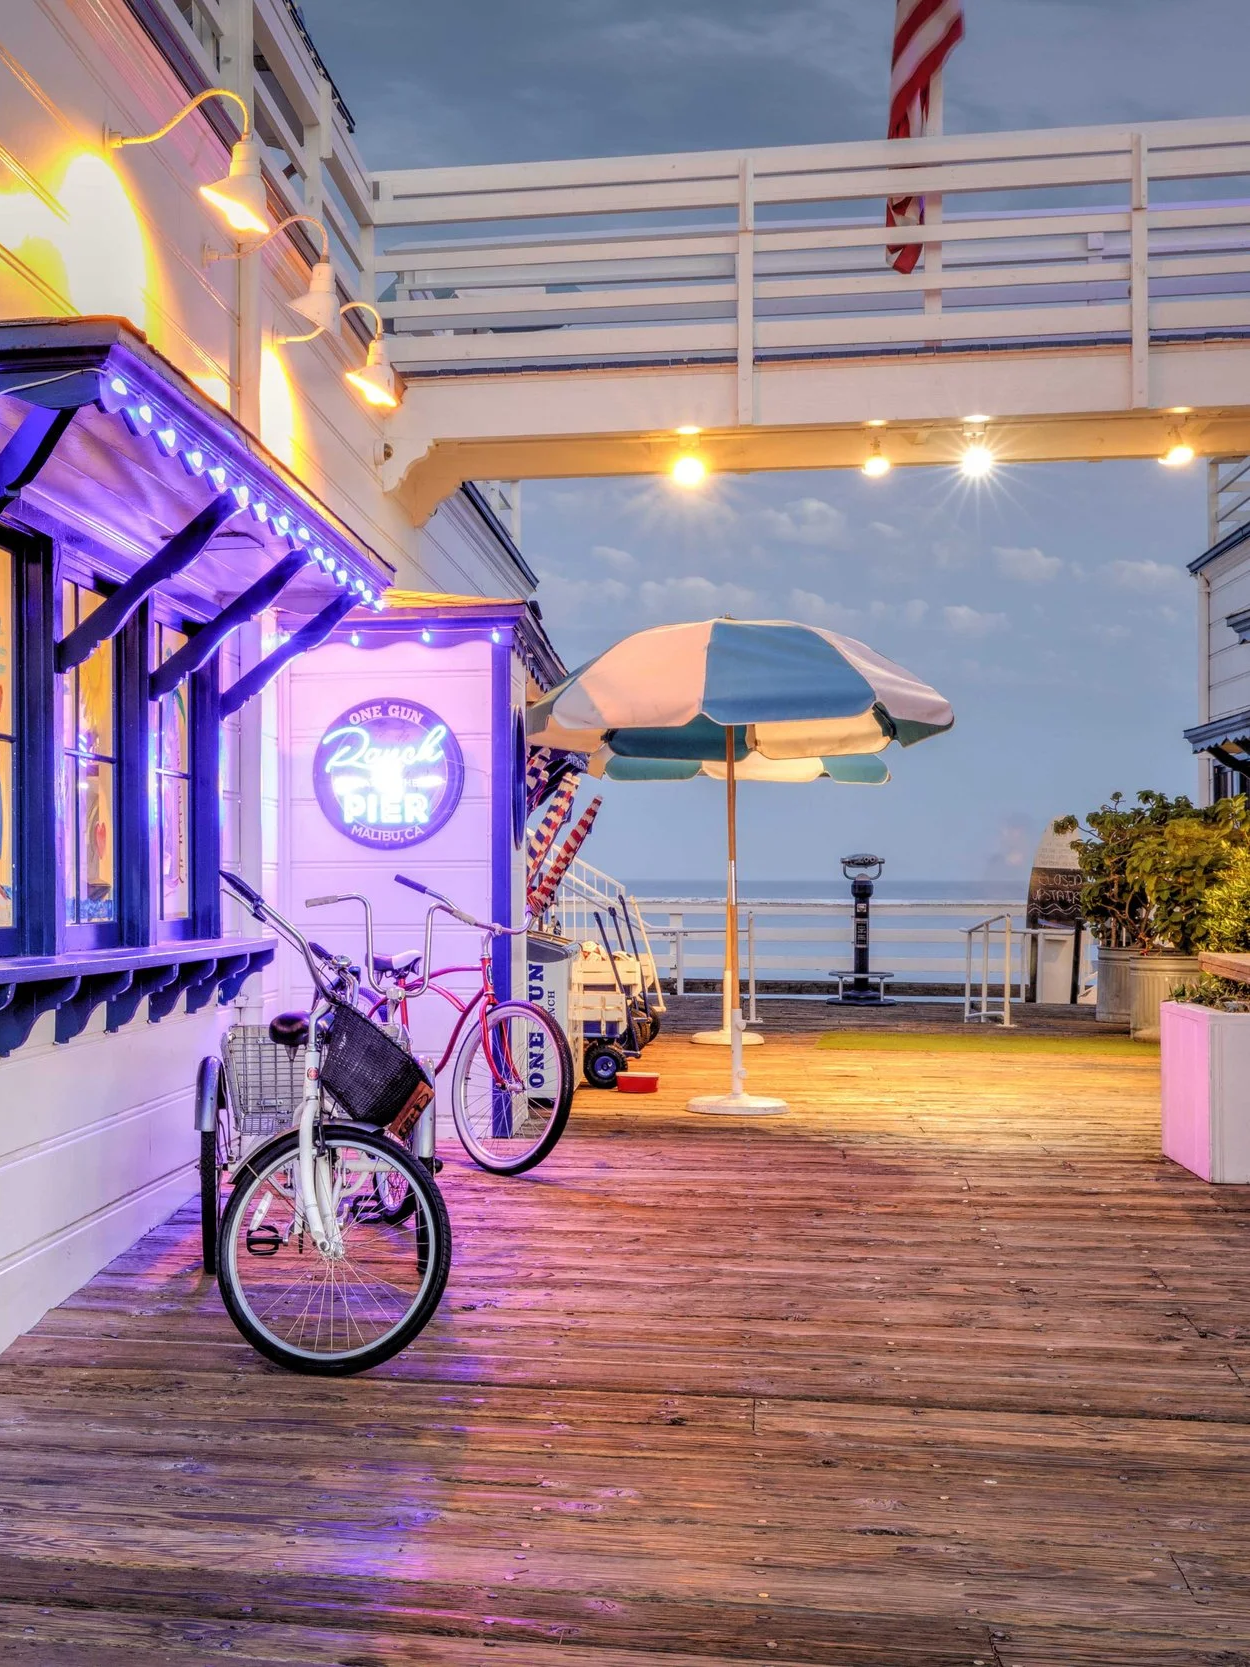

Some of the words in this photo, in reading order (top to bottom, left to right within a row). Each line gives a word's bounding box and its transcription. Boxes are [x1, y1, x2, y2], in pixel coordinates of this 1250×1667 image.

[349, 705, 383, 726] ONE
[388, 705, 424, 725] GUN
[343, 792, 430, 824] PIER
[1032, 888, 1082, 904] UPSTAIR
[528, 964, 545, 1007] UN
[528, 1032, 545, 1088] ONE
